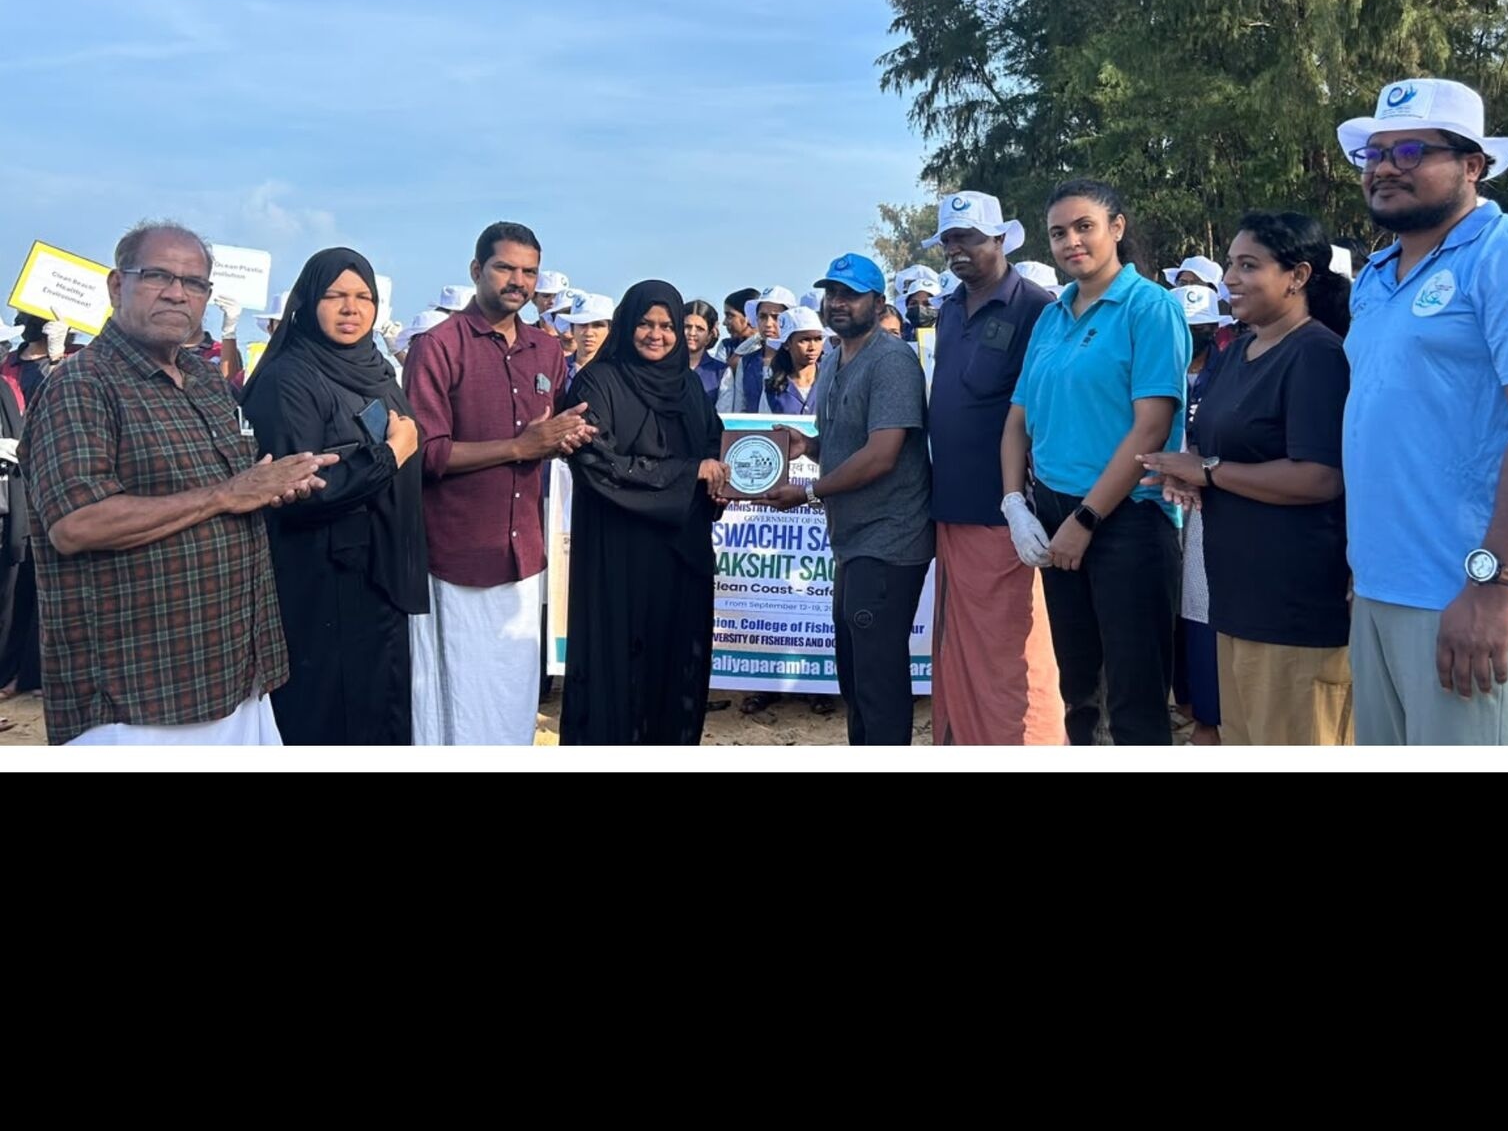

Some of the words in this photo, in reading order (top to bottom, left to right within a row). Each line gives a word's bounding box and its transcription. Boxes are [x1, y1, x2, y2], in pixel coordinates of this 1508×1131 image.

[744, 515, 799, 524] GOVERNMENT
[712, 522, 803, 550] SWACHH
[714, 552, 795, 580] AKSHIT
[751, 583, 793, 595] Coast
[749, 601, 797, 611] September
[714, 617, 738, 630] ion,
[741, 618, 787, 633] College
[790, 621, 802, 633] of
[713, 632, 748, 644] VERSITY
[749, 634, 760, 645] OF
[761, 635, 804, 647] FISHERIES
[805, 637, 824, 648] AND
[713, 655, 820, 675] aliyaparamba
